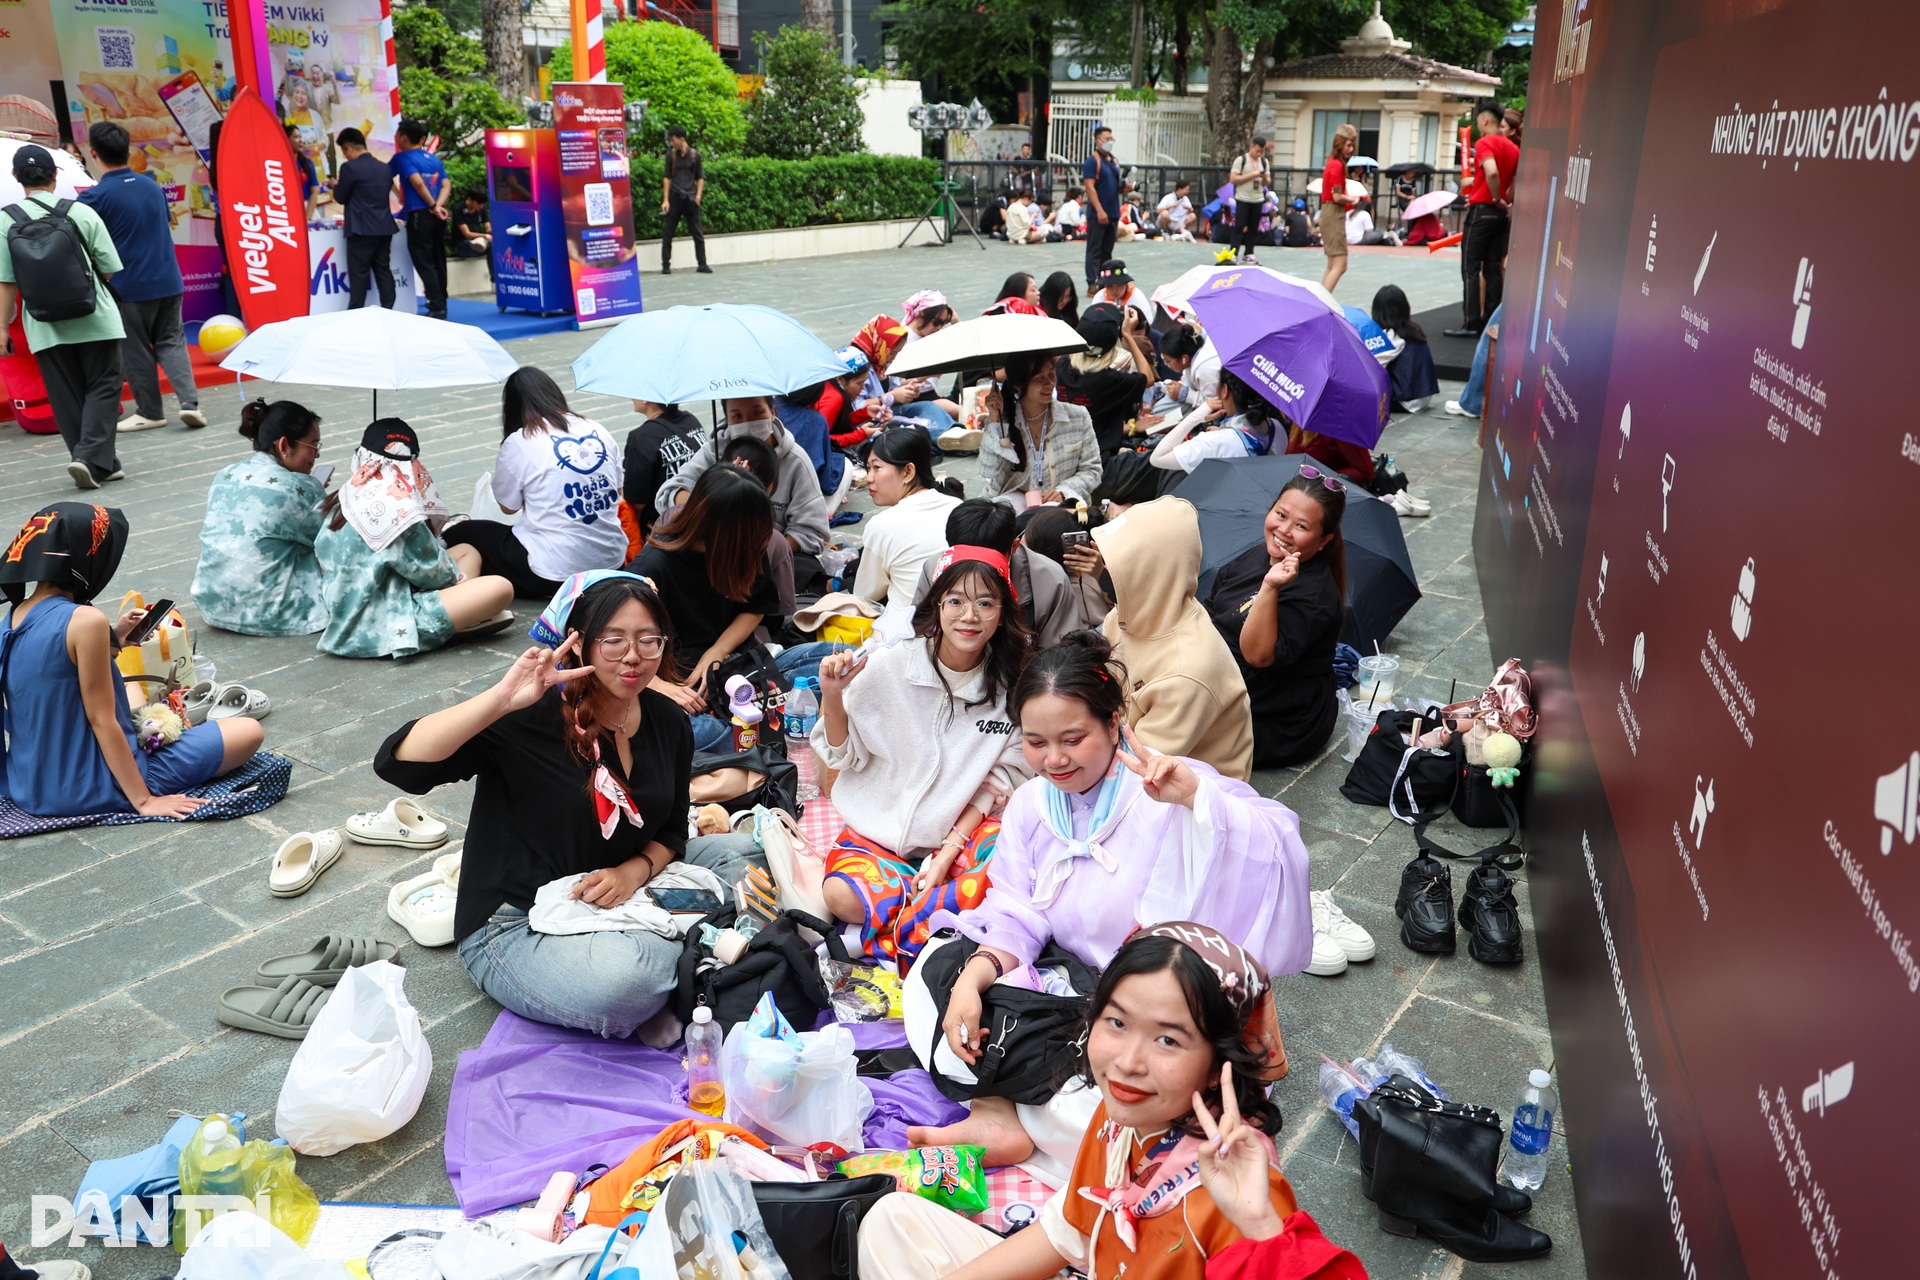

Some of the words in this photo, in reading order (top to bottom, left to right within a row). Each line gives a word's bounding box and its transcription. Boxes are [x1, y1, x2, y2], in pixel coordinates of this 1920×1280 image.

[268, 22, 311, 49] ÀNG
[312, 30, 329, 48] ký
[287, 7, 325, 22] Vikki
[1711, 102, 1757, 155] NHỮNG
[1756, 99, 1787, 170] VẬT
[1783, 107, 1837, 172] DỤNG
[1834, 86, 1920, 163] KHÔNG
[233, 201, 278, 295] vietjet
[1253, 354, 1278, 379] CHÍN
[1365, 335, 1386, 351] GS25
[1250, 367, 1271, 385] KHÔNG
[1753, 347, 1767, 368] Chất
[1765, 355, 1779, 376] kích
[1795, 372, 1811, 397] chất
[1750, 372, 1759, 396] bật
[1769, 386, 1787, 412] thuốc
[1794, 403, 1814, 430] thuốc
[1812, 416, 1822, 436] lá
[1767, 414, 1782, 440] điện
[1727, 695, 1746, 733] 26x26
[1743, 726, 1754, 749] cm
[1823, 819, 1842, 859] Các
[1840, 848, 1864, 895] thiết
[1861, 879, 1875, 917] bị
[1872, 899, 1891, 940] tạo
[1890, 928, 1920, 993] tiếng
[1599, 906, 1628, 1017] LIVESTREAM
[1624, 1004, 1644, 1081] TRONG
[1640, 1072, 1659, 1140] SUỐT
[1655, 1130, 1674, 1204] THỜI
[1670, 1195, 1691, 1274] GIAN
[1776, 1086, 1796, 1140] Pháo
[1768, 1115, 1787, 1163] cháy
